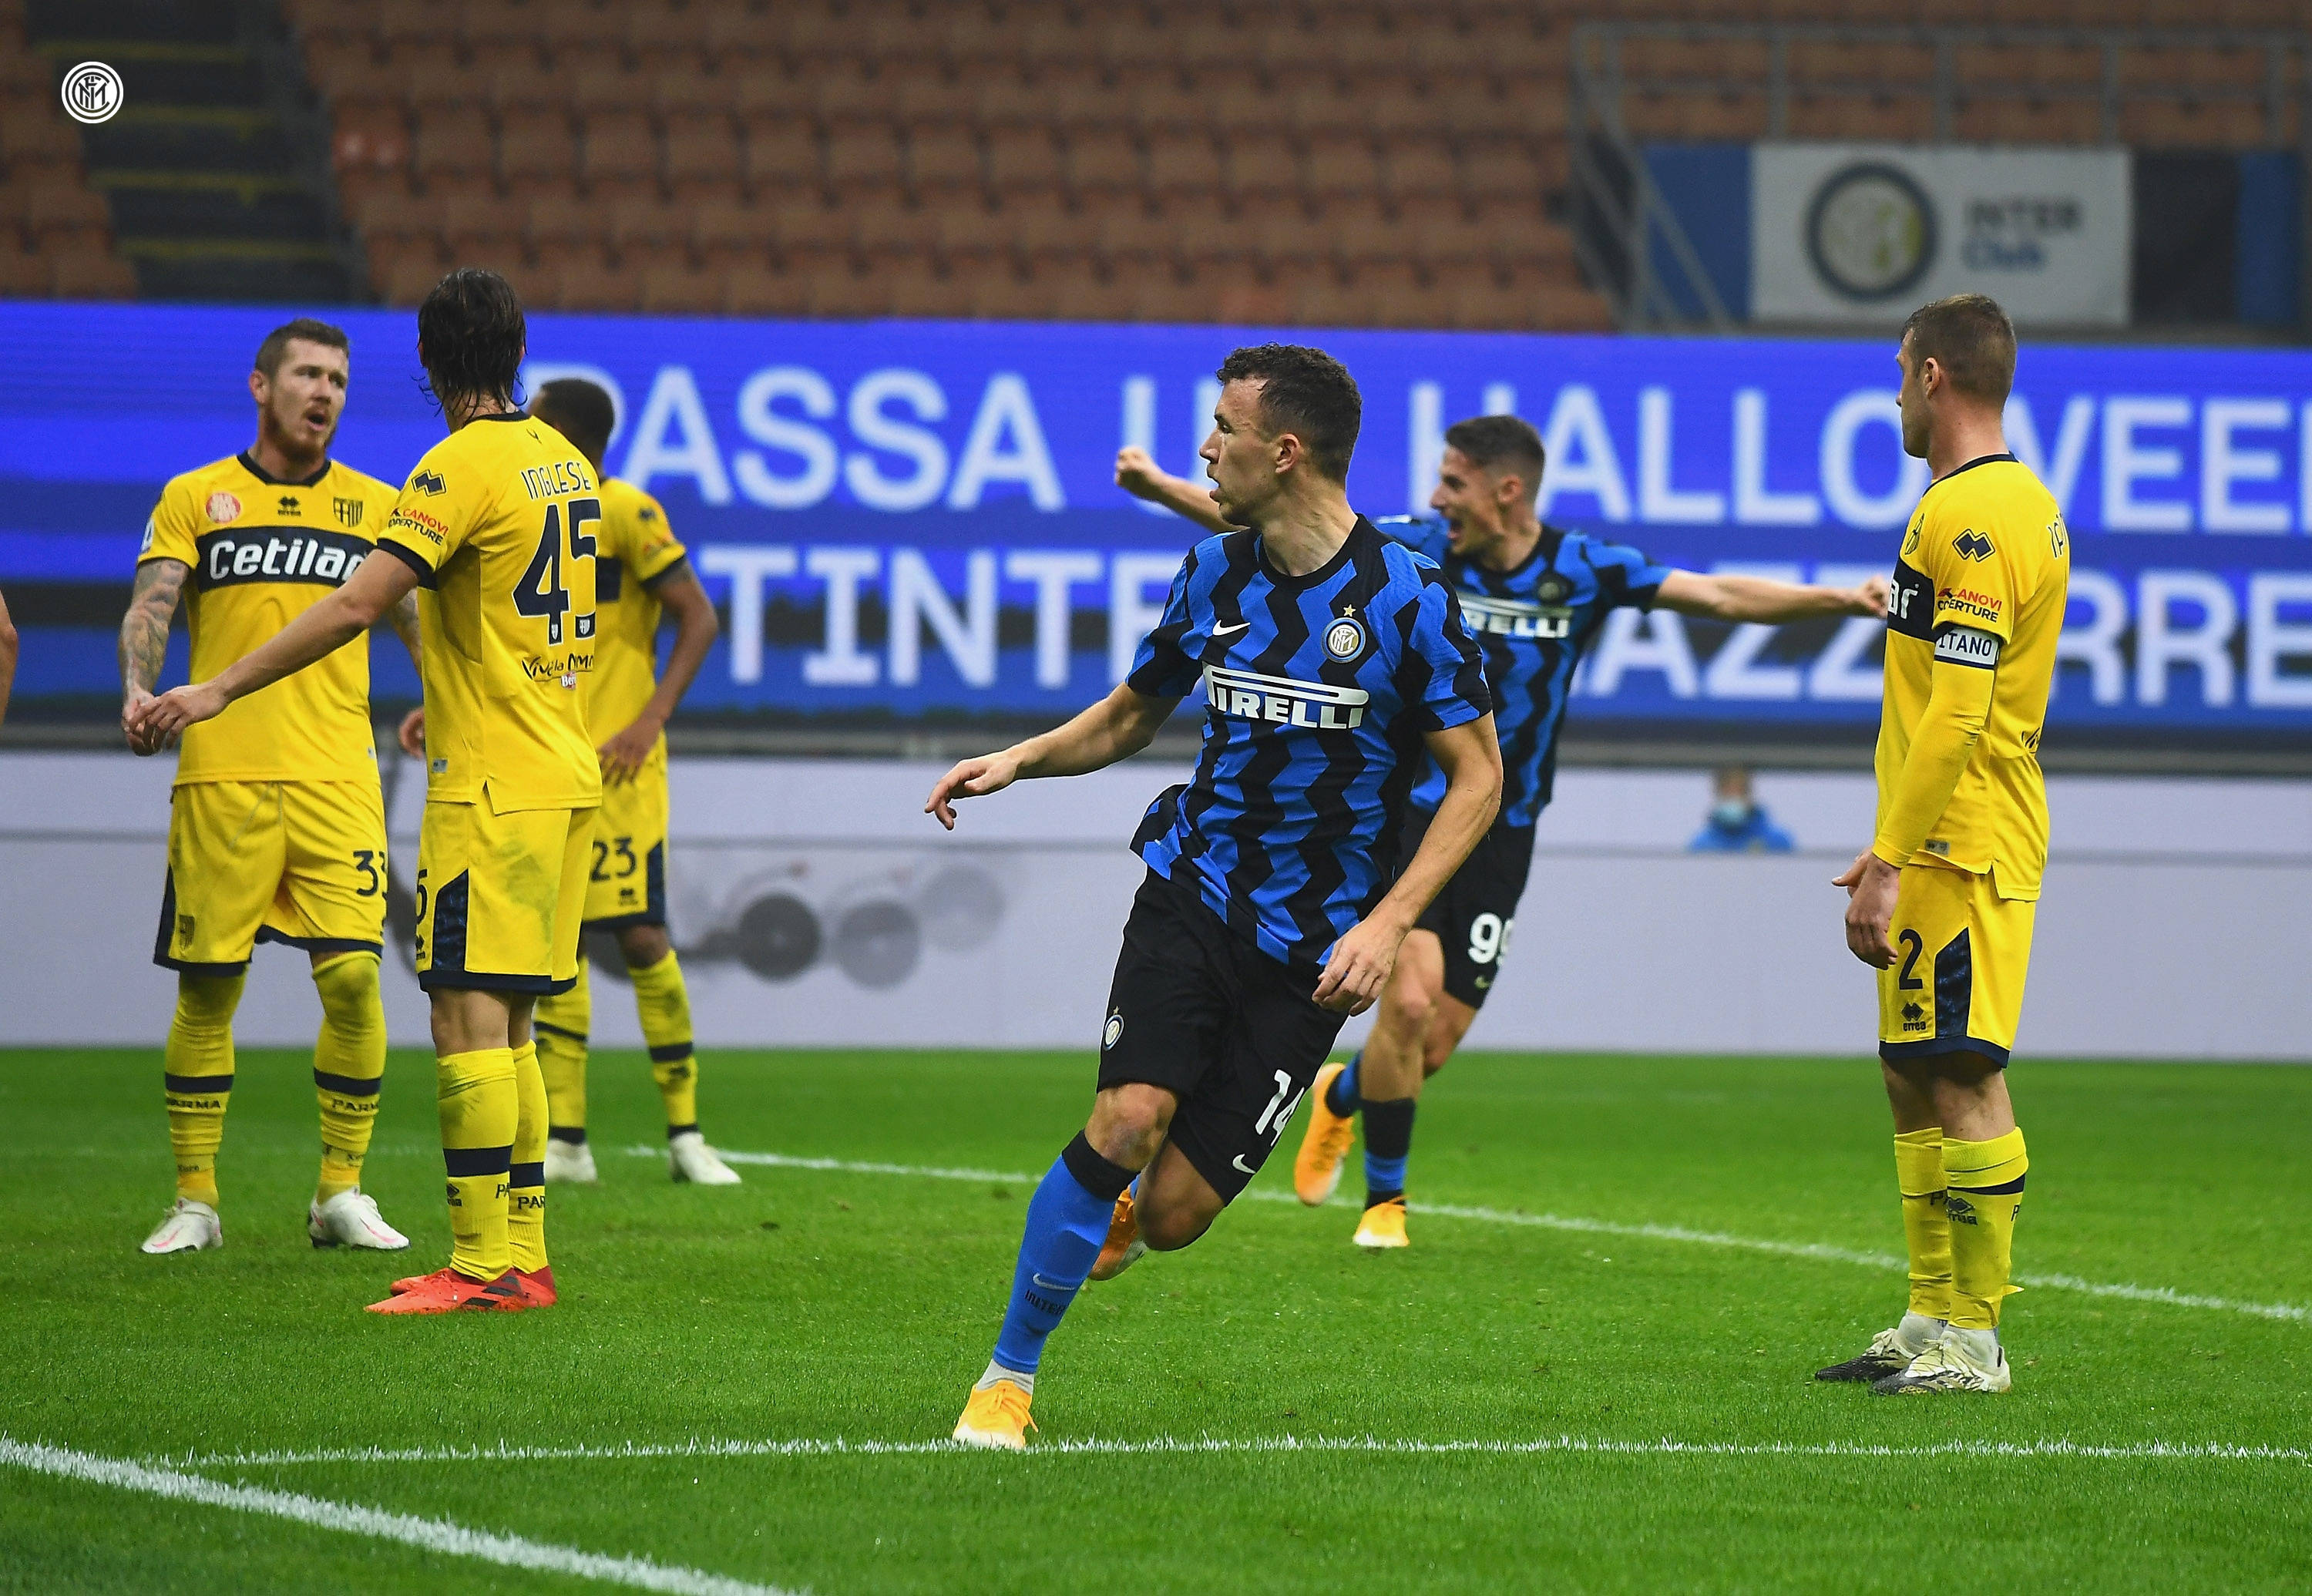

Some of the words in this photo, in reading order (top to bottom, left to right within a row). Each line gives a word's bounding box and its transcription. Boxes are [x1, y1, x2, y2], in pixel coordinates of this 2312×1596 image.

[520, 461, 593, 501] INGLESE
[512, 498, 601, 647] 45
[1202, 661, 1370, 730] PIRELLI
[591, 836, 637, 882] 23
[1898, 928, 1924, 990] 2
